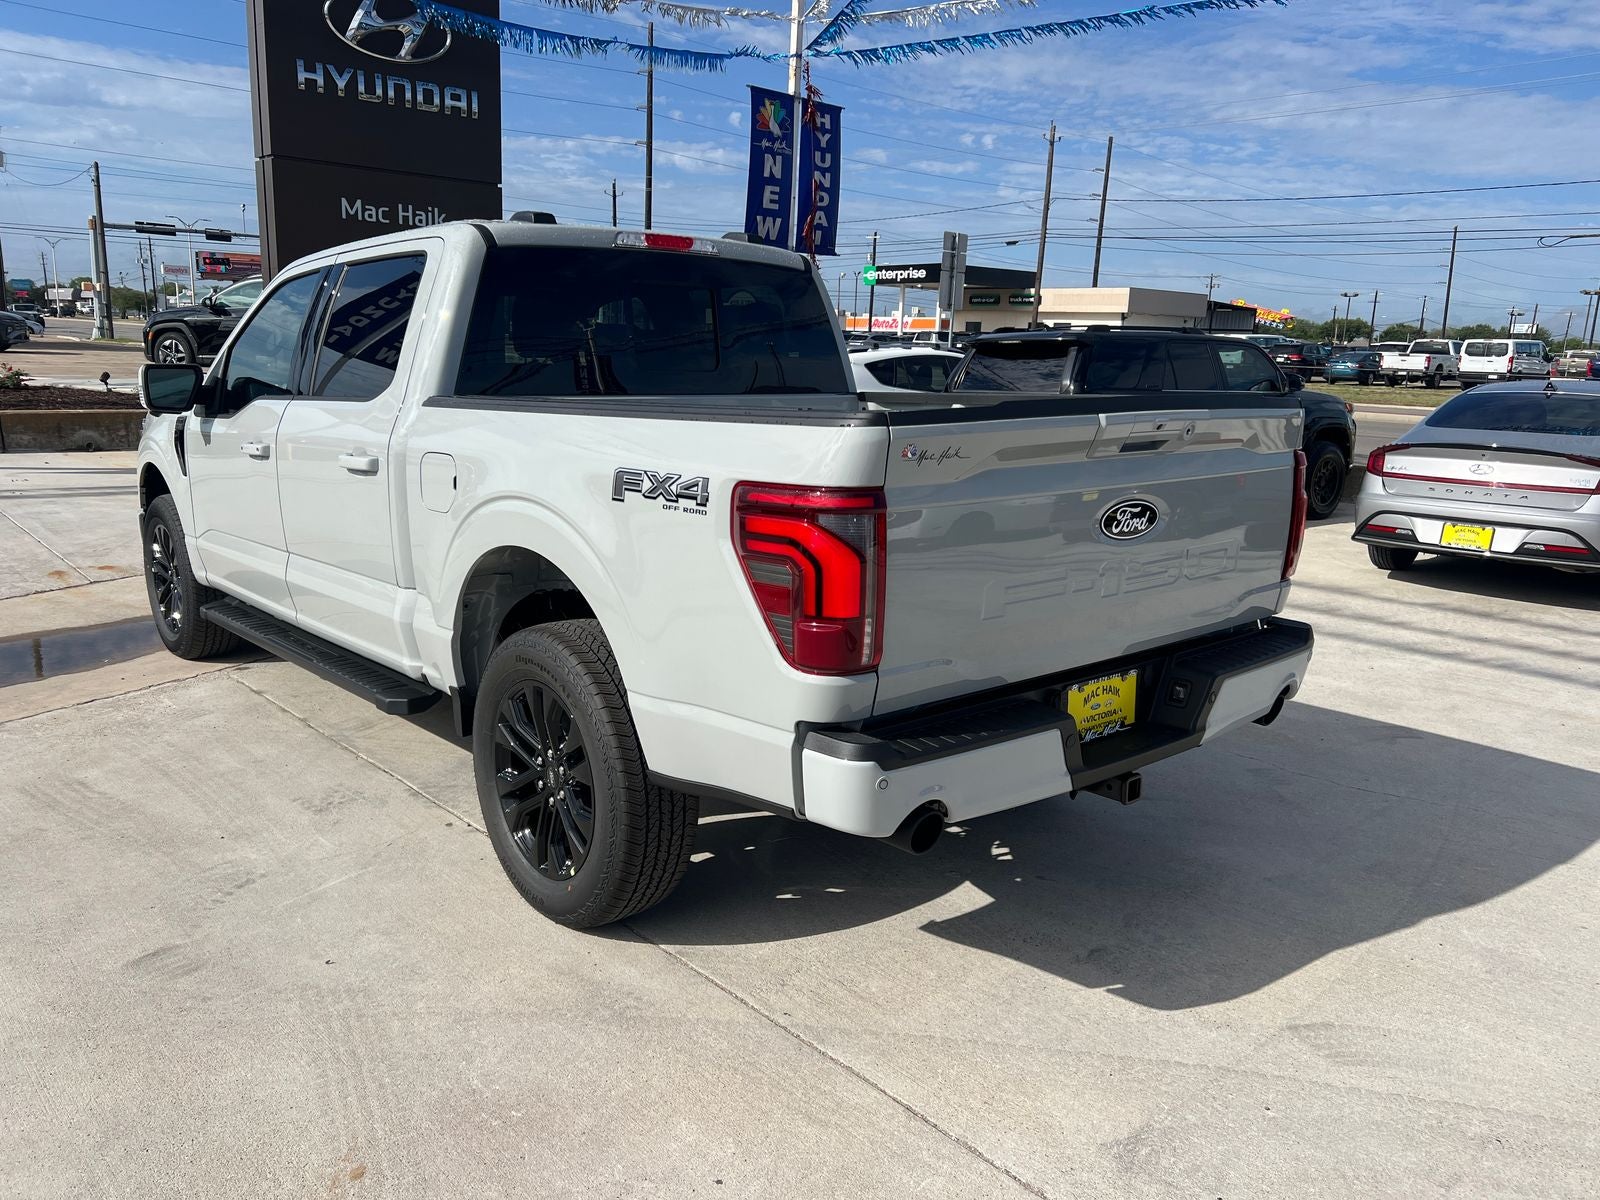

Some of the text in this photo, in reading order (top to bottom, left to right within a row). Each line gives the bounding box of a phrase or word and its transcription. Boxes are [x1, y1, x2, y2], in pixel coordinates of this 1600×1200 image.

[295, 58, 479, 119] HYUNDAI
[814, 112, 832, 245] HYUNDAI
[756, 153, 783, 241] NEW
[340, 197, 447, 227] Mac Haik
[867, 267, 926, 282] enterprise
[612, 467, 710, 508] FX4
[1427, 487, 1529, 500] SONATA
[682, 506, 707, 516] ROAD
[1111, 506, 1150, 534] Ford
[1083, 684, 1121, 708] MAC HAIK
